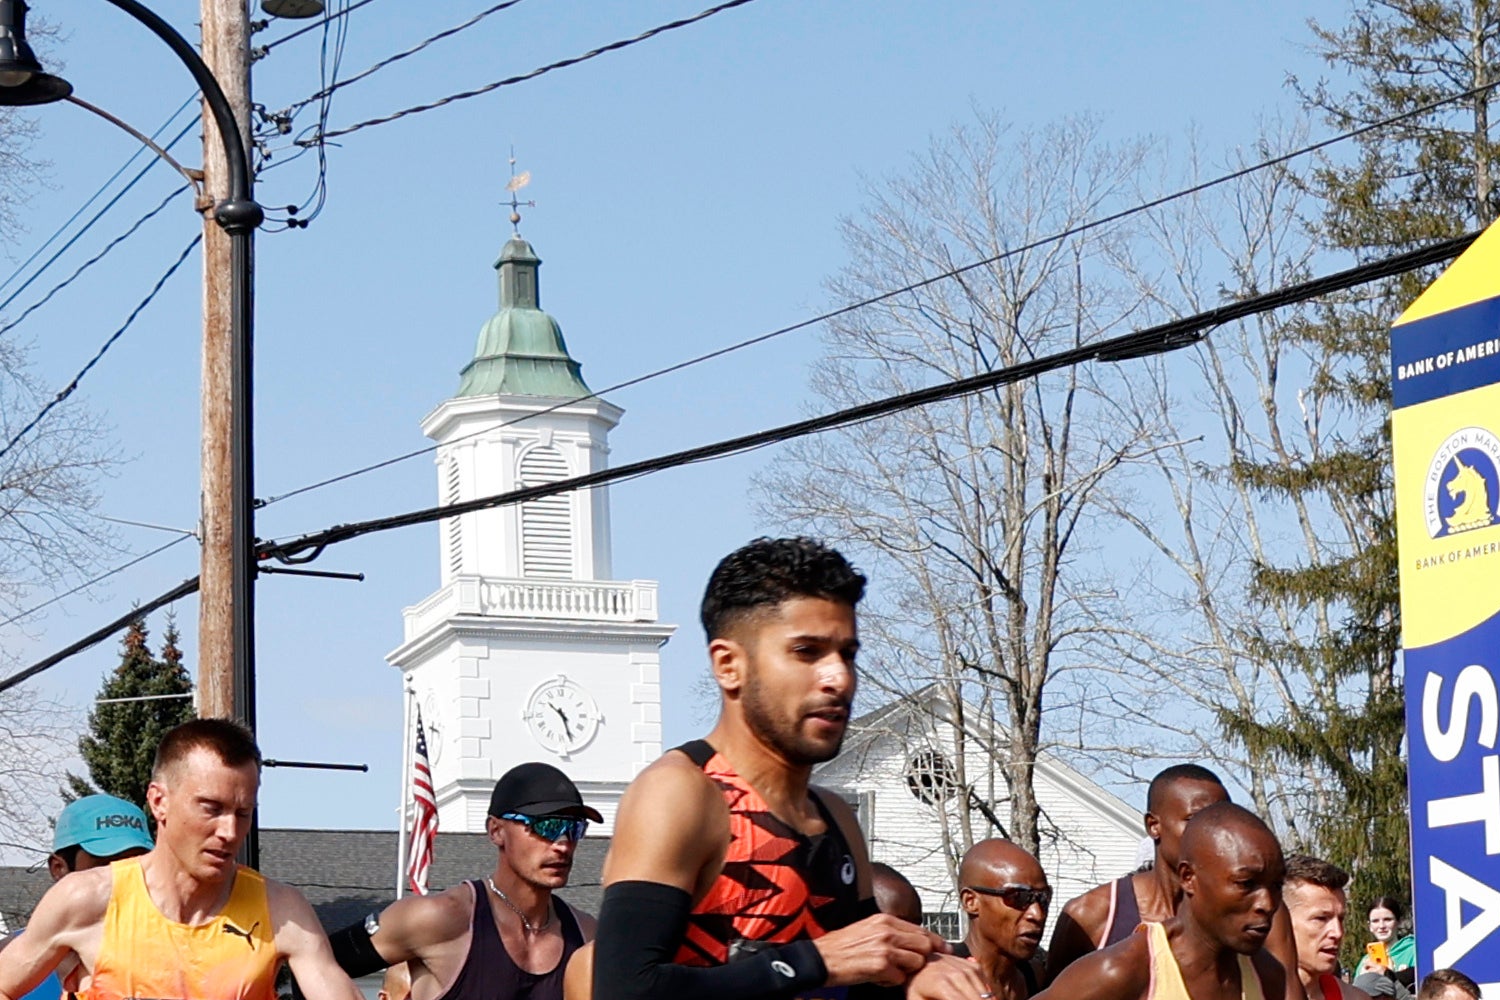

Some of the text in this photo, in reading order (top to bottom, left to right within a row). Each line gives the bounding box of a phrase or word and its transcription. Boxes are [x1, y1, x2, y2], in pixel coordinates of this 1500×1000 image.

[1397, 356, 1434, 380] BANK
[1436, 351, 1454, 369] OF
[1431, 433, 1469, 482] BOSTON
[1427, 492, 1437, 525] THE
[1415, 553, 1445, 571] BANK
[1448, 550, 1462, 563] OF
[96, 814, 145, 833] HOKA
